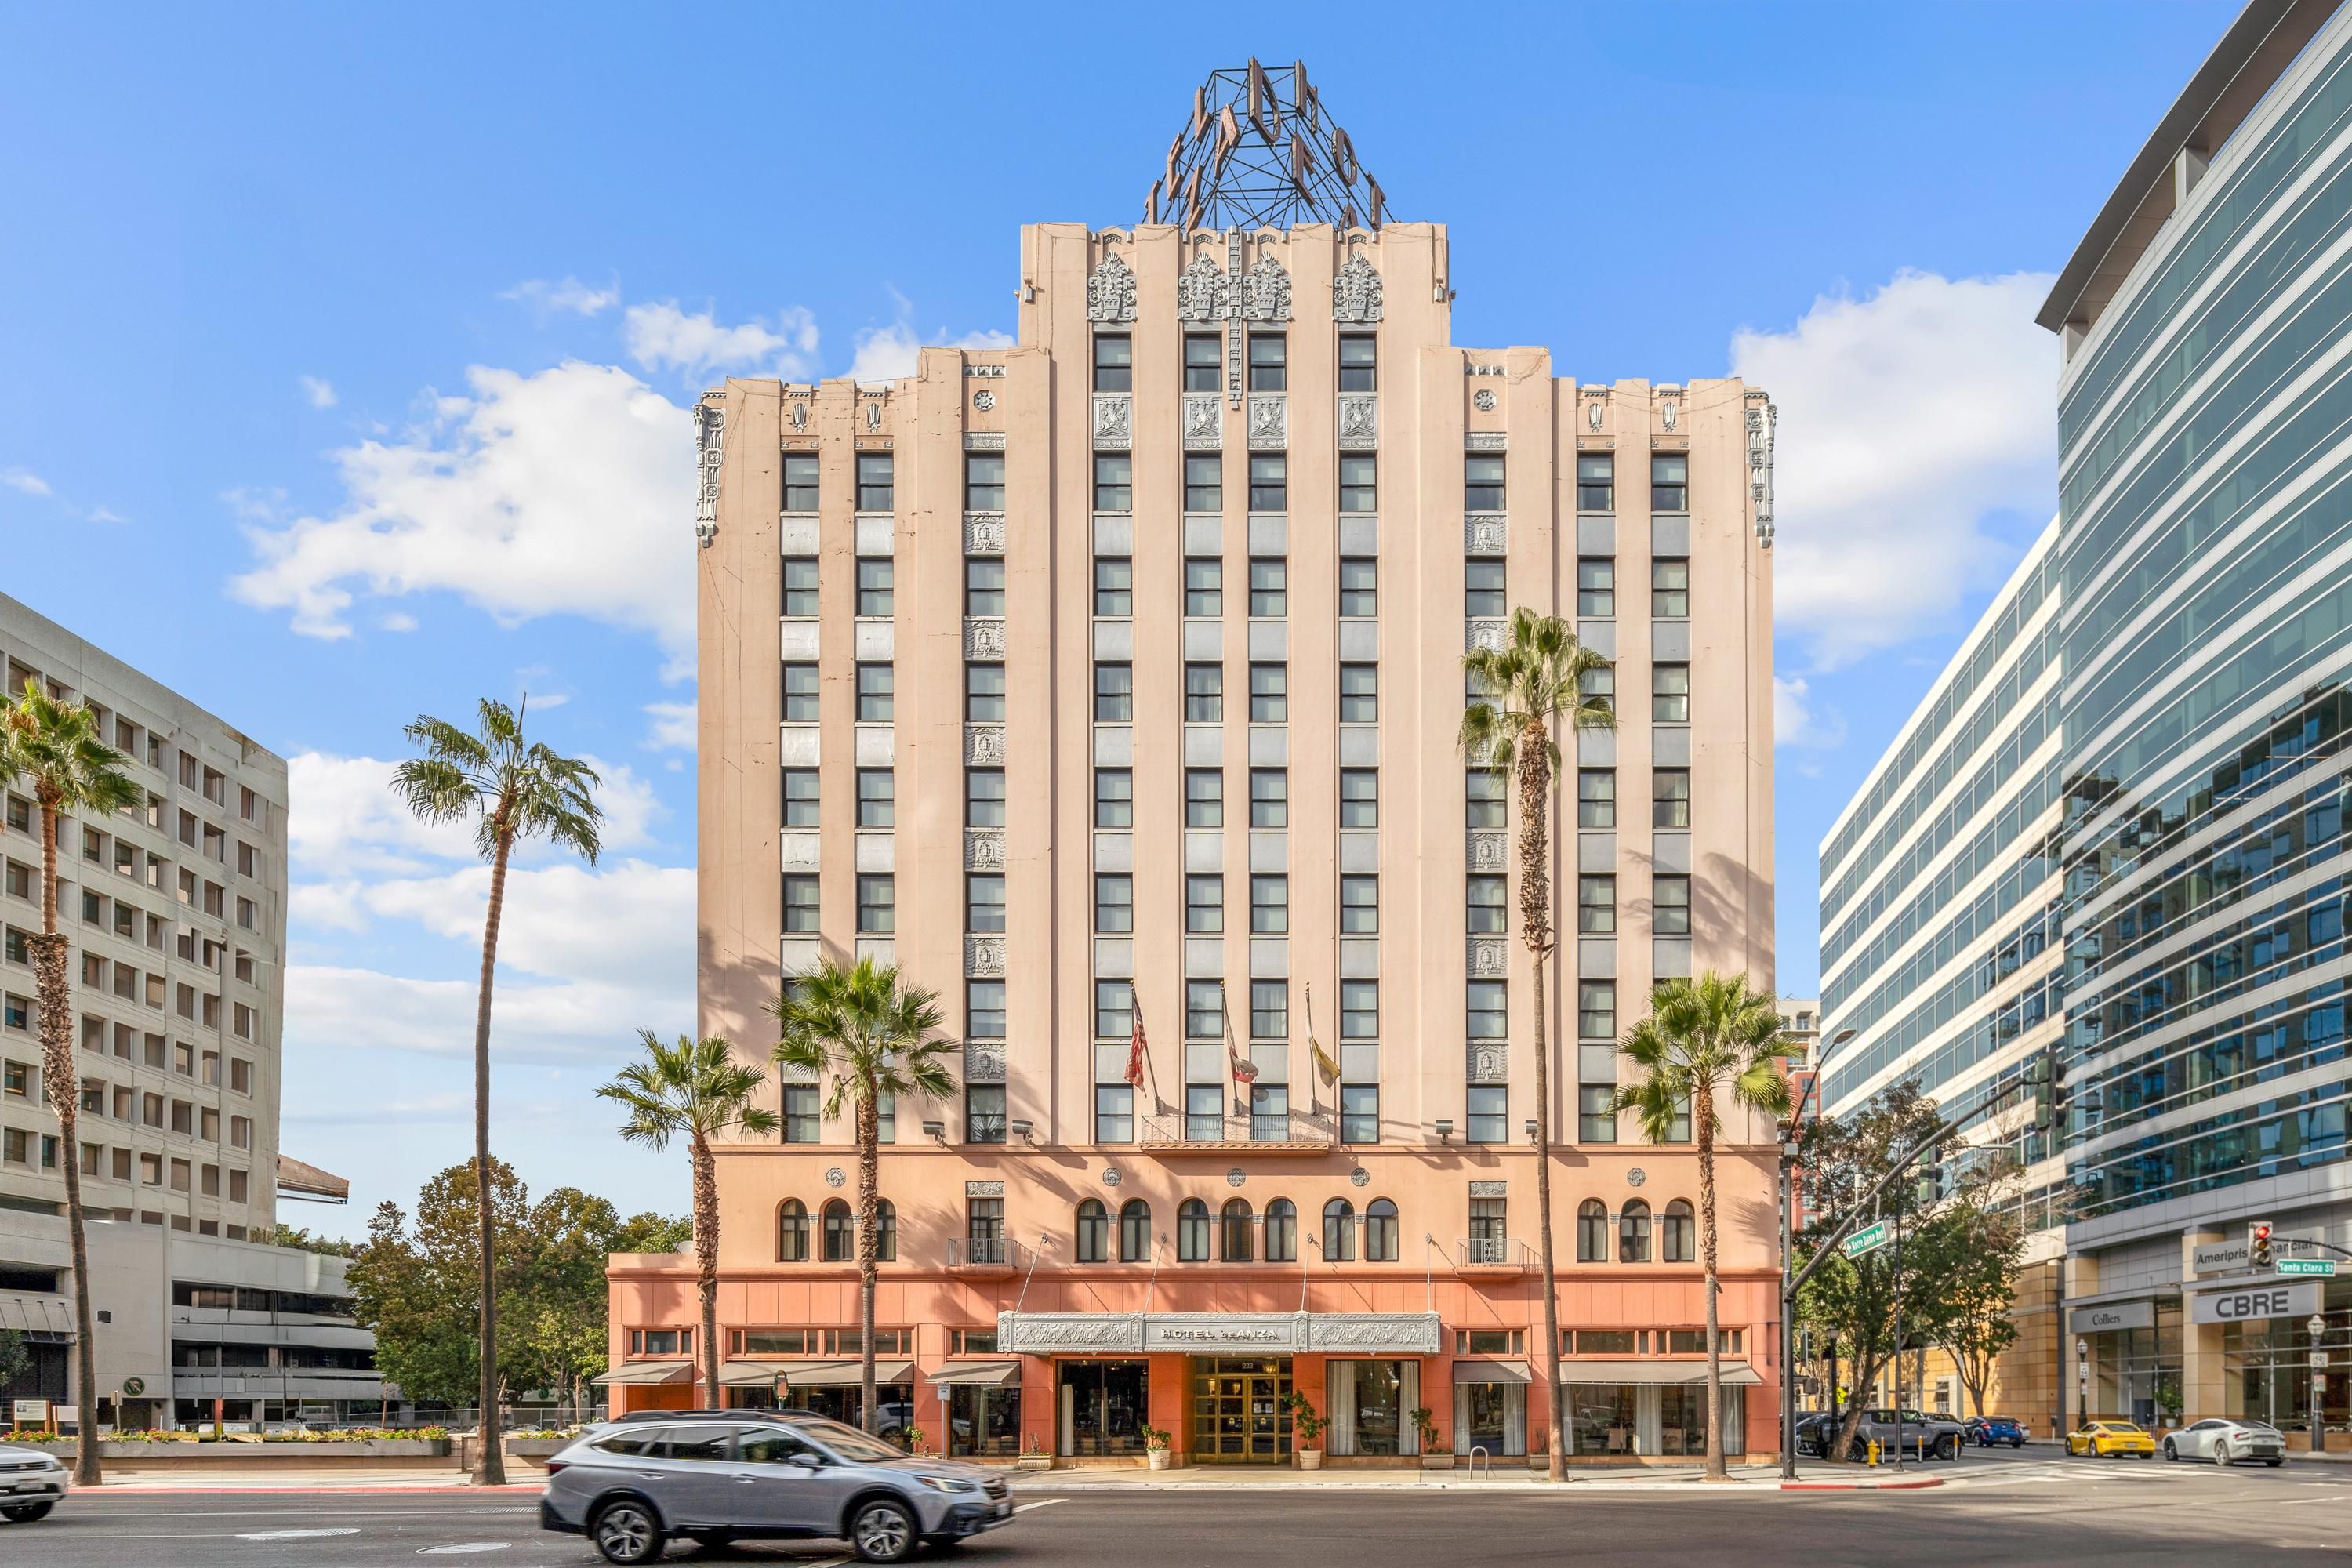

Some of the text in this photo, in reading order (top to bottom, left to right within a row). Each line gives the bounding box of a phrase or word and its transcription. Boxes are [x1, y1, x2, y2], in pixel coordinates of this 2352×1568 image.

[1875, 1229, 1884, 1240] Ave
[2196, 1247, 2249, 1265] Ameripris
[2278, 1262, 2334, 1273] Santa Clara St
[2216, 1290, 2289, 1318] CBRE
[2092, 1313, 2121, 1326] Colliers
[1161, 1328, 1216, 1338] HOTEL
[1236, 1328, 1278, 1339] ANZA
